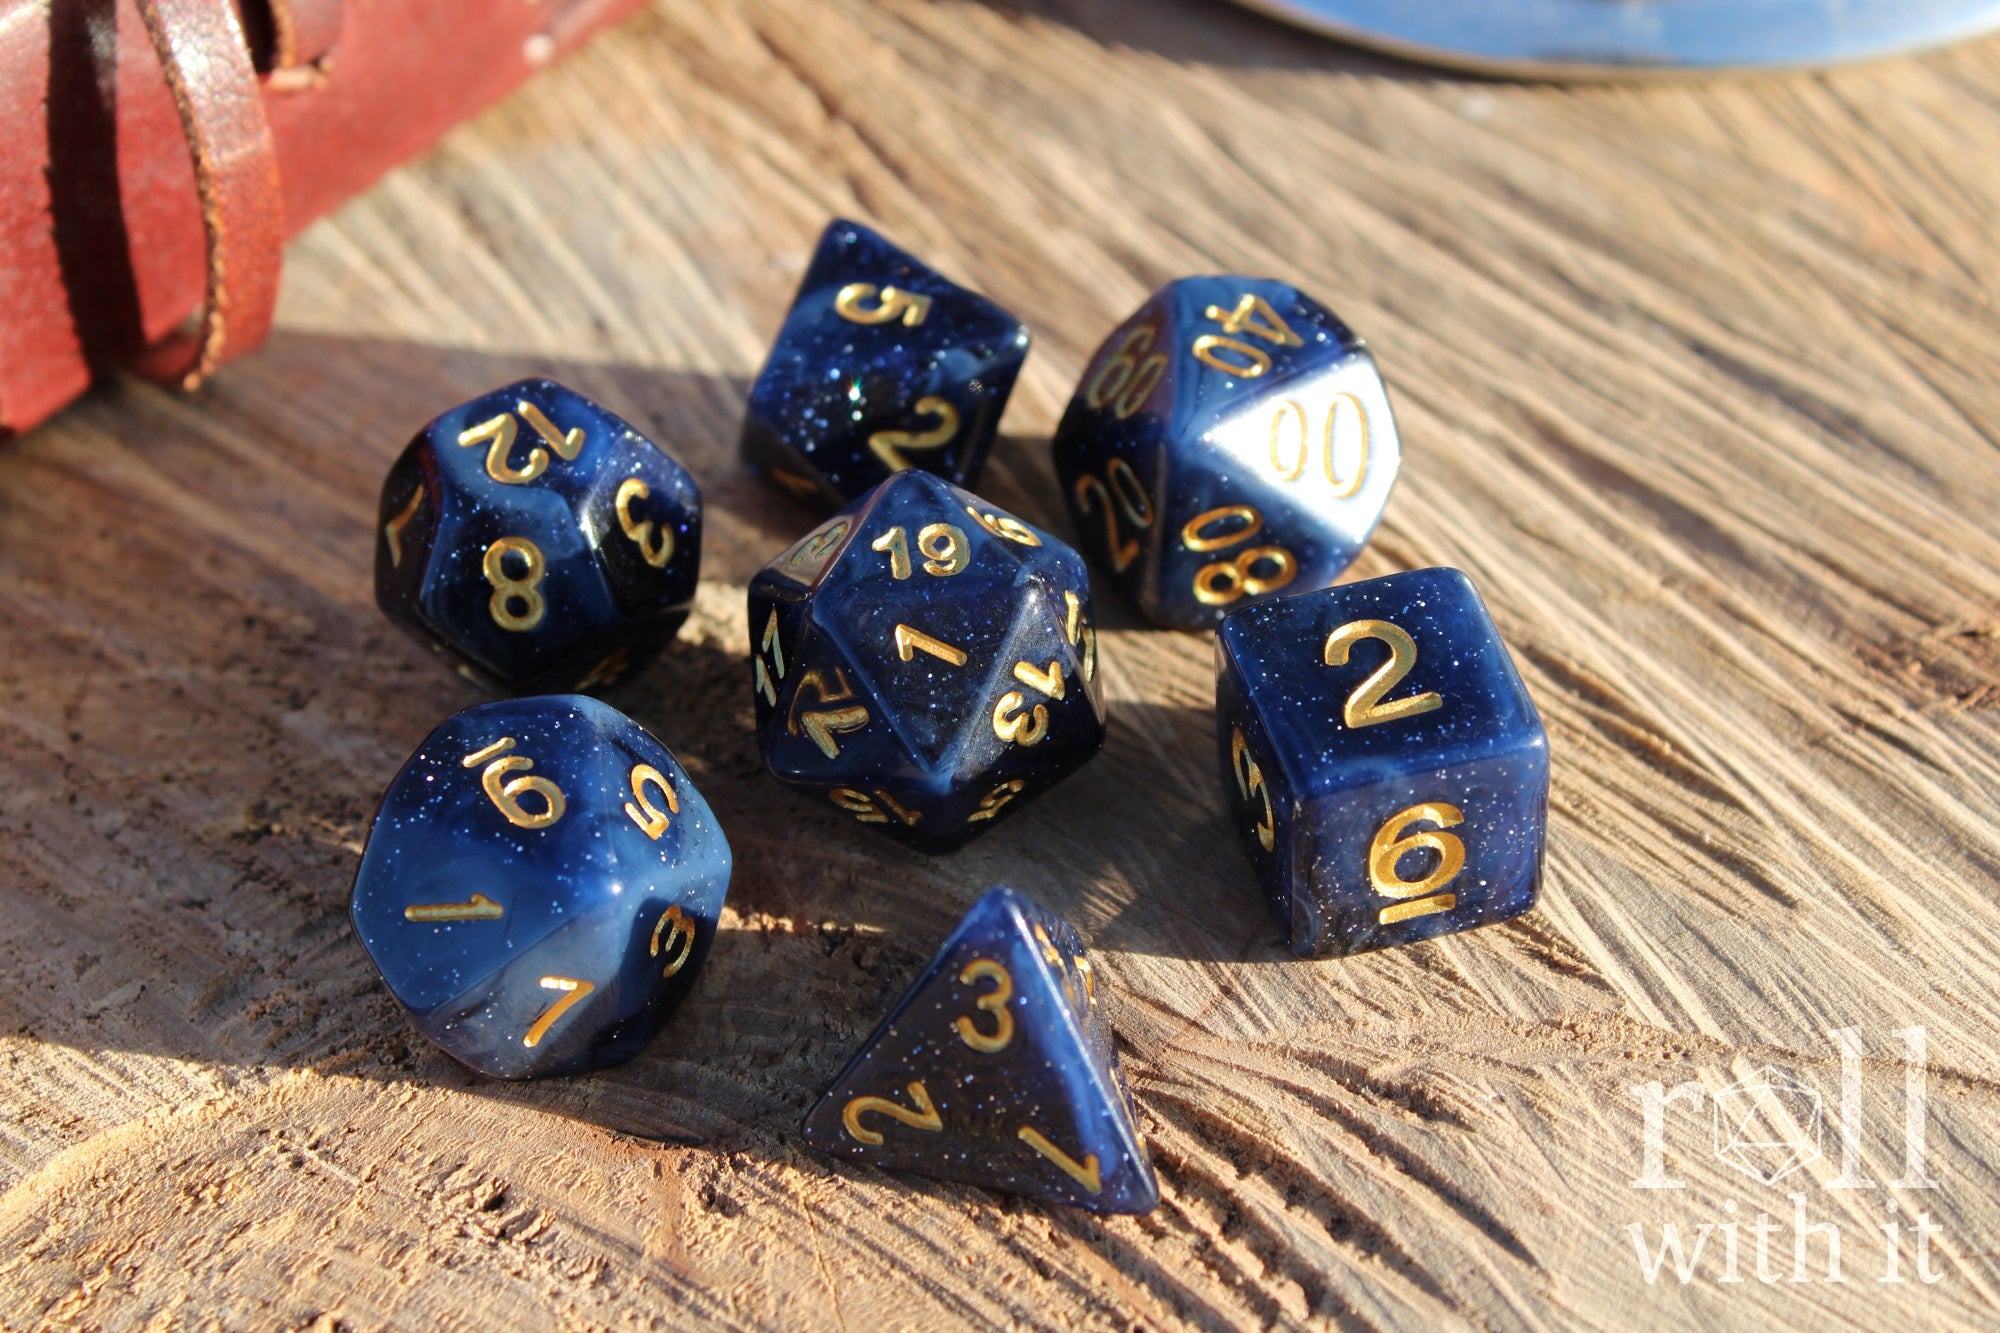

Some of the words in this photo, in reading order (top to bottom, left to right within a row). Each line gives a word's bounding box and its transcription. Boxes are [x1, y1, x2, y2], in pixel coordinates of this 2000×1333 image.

[834, 282, 932, 328] 5
[1191, 293, 1305, 379] 40
[457, 399, 587, 485] 12
[867, 395, 961, 473] 2
[1268, 391, 1370, 500] 00
[615, 477, 675, 569] 3
[871, 521, 971, 581] 19
[1076, 457, 1154, 573] 20
[1181, 504, 1299, 606] 80
[482, 535, 546, 632] 8
[894, 622, 968, 667] 1
[1324, 618, 1444, 729] 2
[991, 660, 1067, 747] 13
[624, 763, 680, 841] 5
[1231, 725, 1275, 852] 3
[1368, 801, 1467, 925] 6
[403, 892, 504, 923] 1
[649, 904, 695, 979] 3
[522, 975, 595, 1048] 7
[956, 957, 1014, 1054] 3
[842, 1081, 943, 1146] 2
[1017, 1125, 1101, 1194] 1
